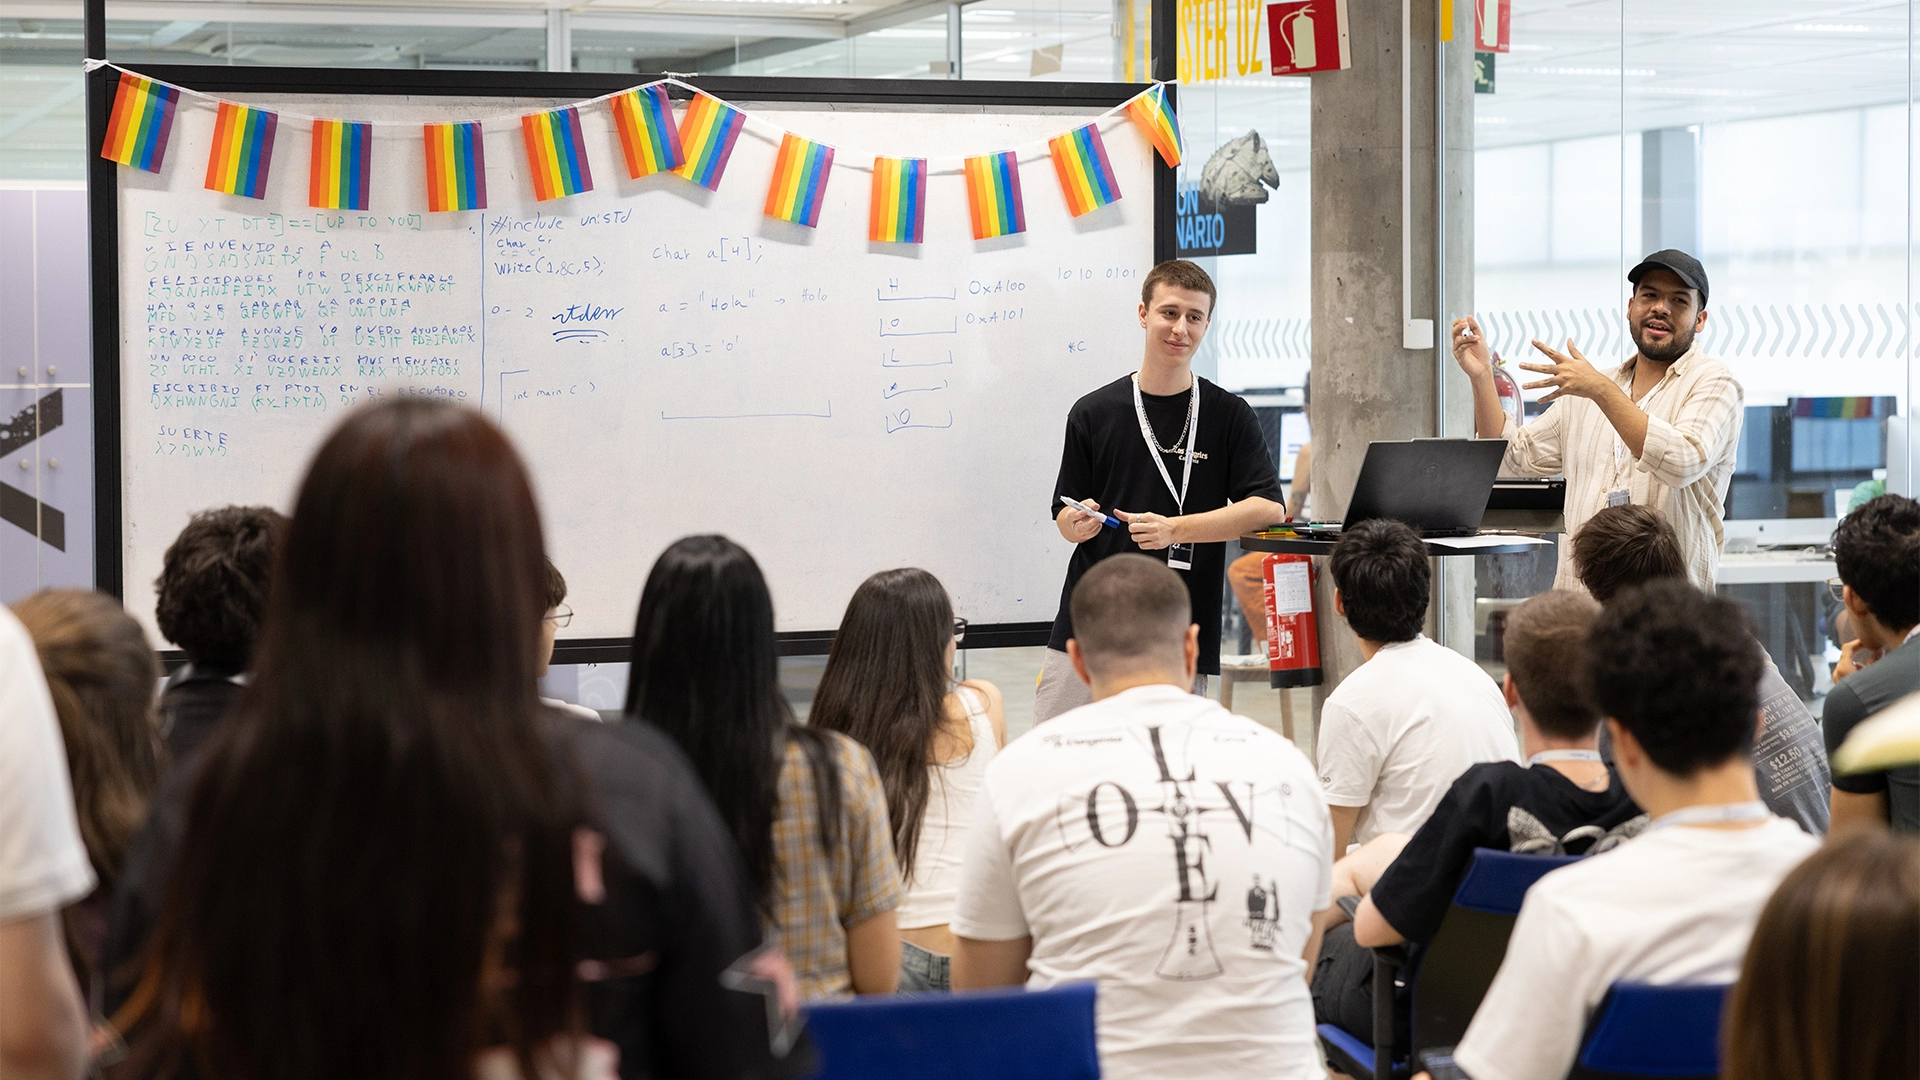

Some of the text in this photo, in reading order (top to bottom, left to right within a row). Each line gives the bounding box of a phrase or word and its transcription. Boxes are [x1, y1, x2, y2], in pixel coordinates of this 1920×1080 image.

[1176, 0, 1228, 86] STER
[357, 216, 378, 228] TO
[489, 212, 565, 236] #include
[341, 250, 360, 262] 42
[889, 278, 899, 293] H
[1778, 724, 1799, 741] $9.50
[1769, 746, 1802, 771] $12.50
